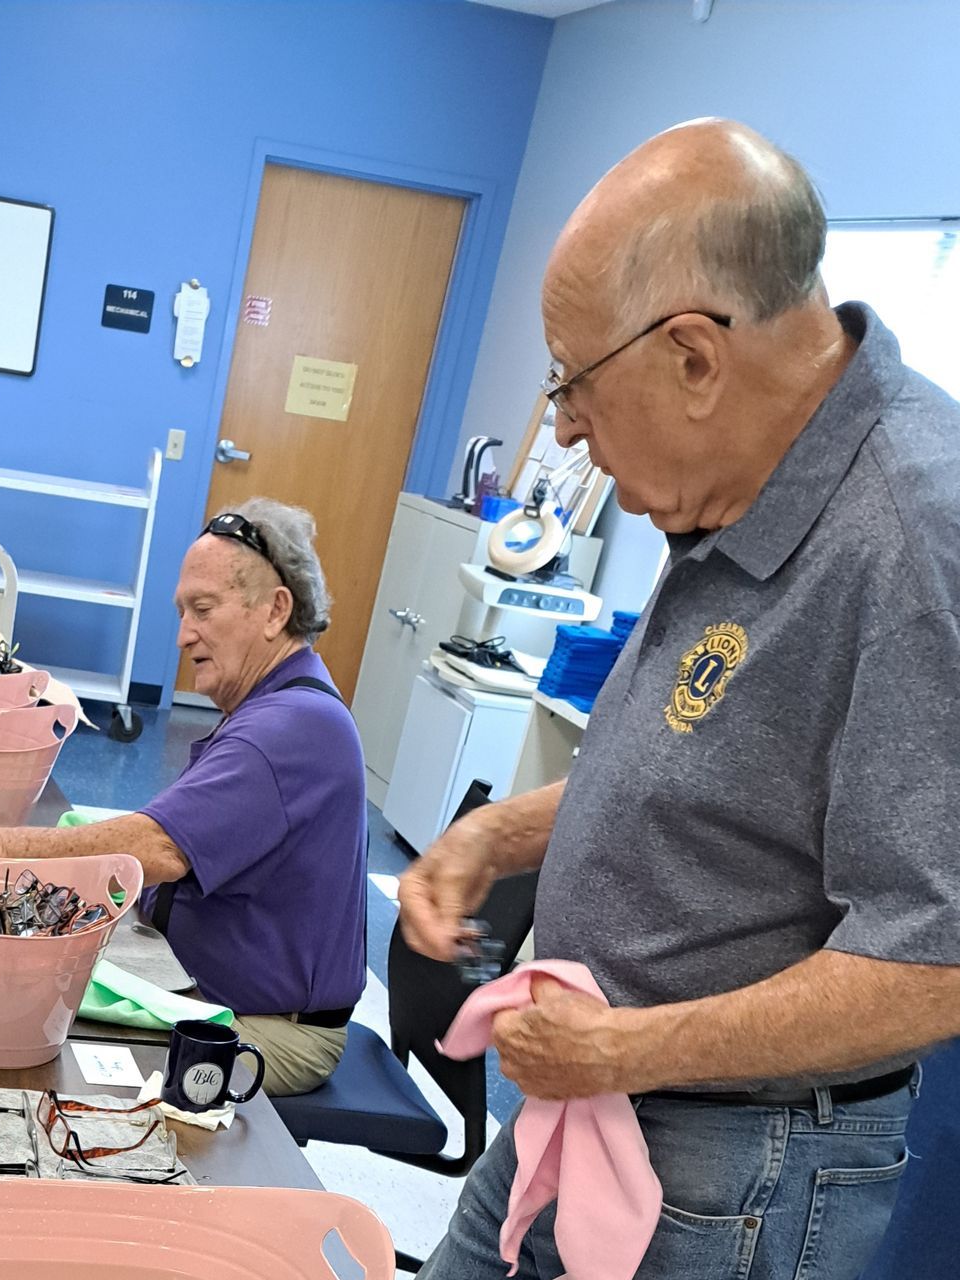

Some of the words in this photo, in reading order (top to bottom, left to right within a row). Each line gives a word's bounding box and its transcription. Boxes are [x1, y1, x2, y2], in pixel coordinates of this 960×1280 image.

[123, 289, 138, 300] 114
[105, 305, 148, 319] MECHANICAL
[694, 659, 718, 693] L
